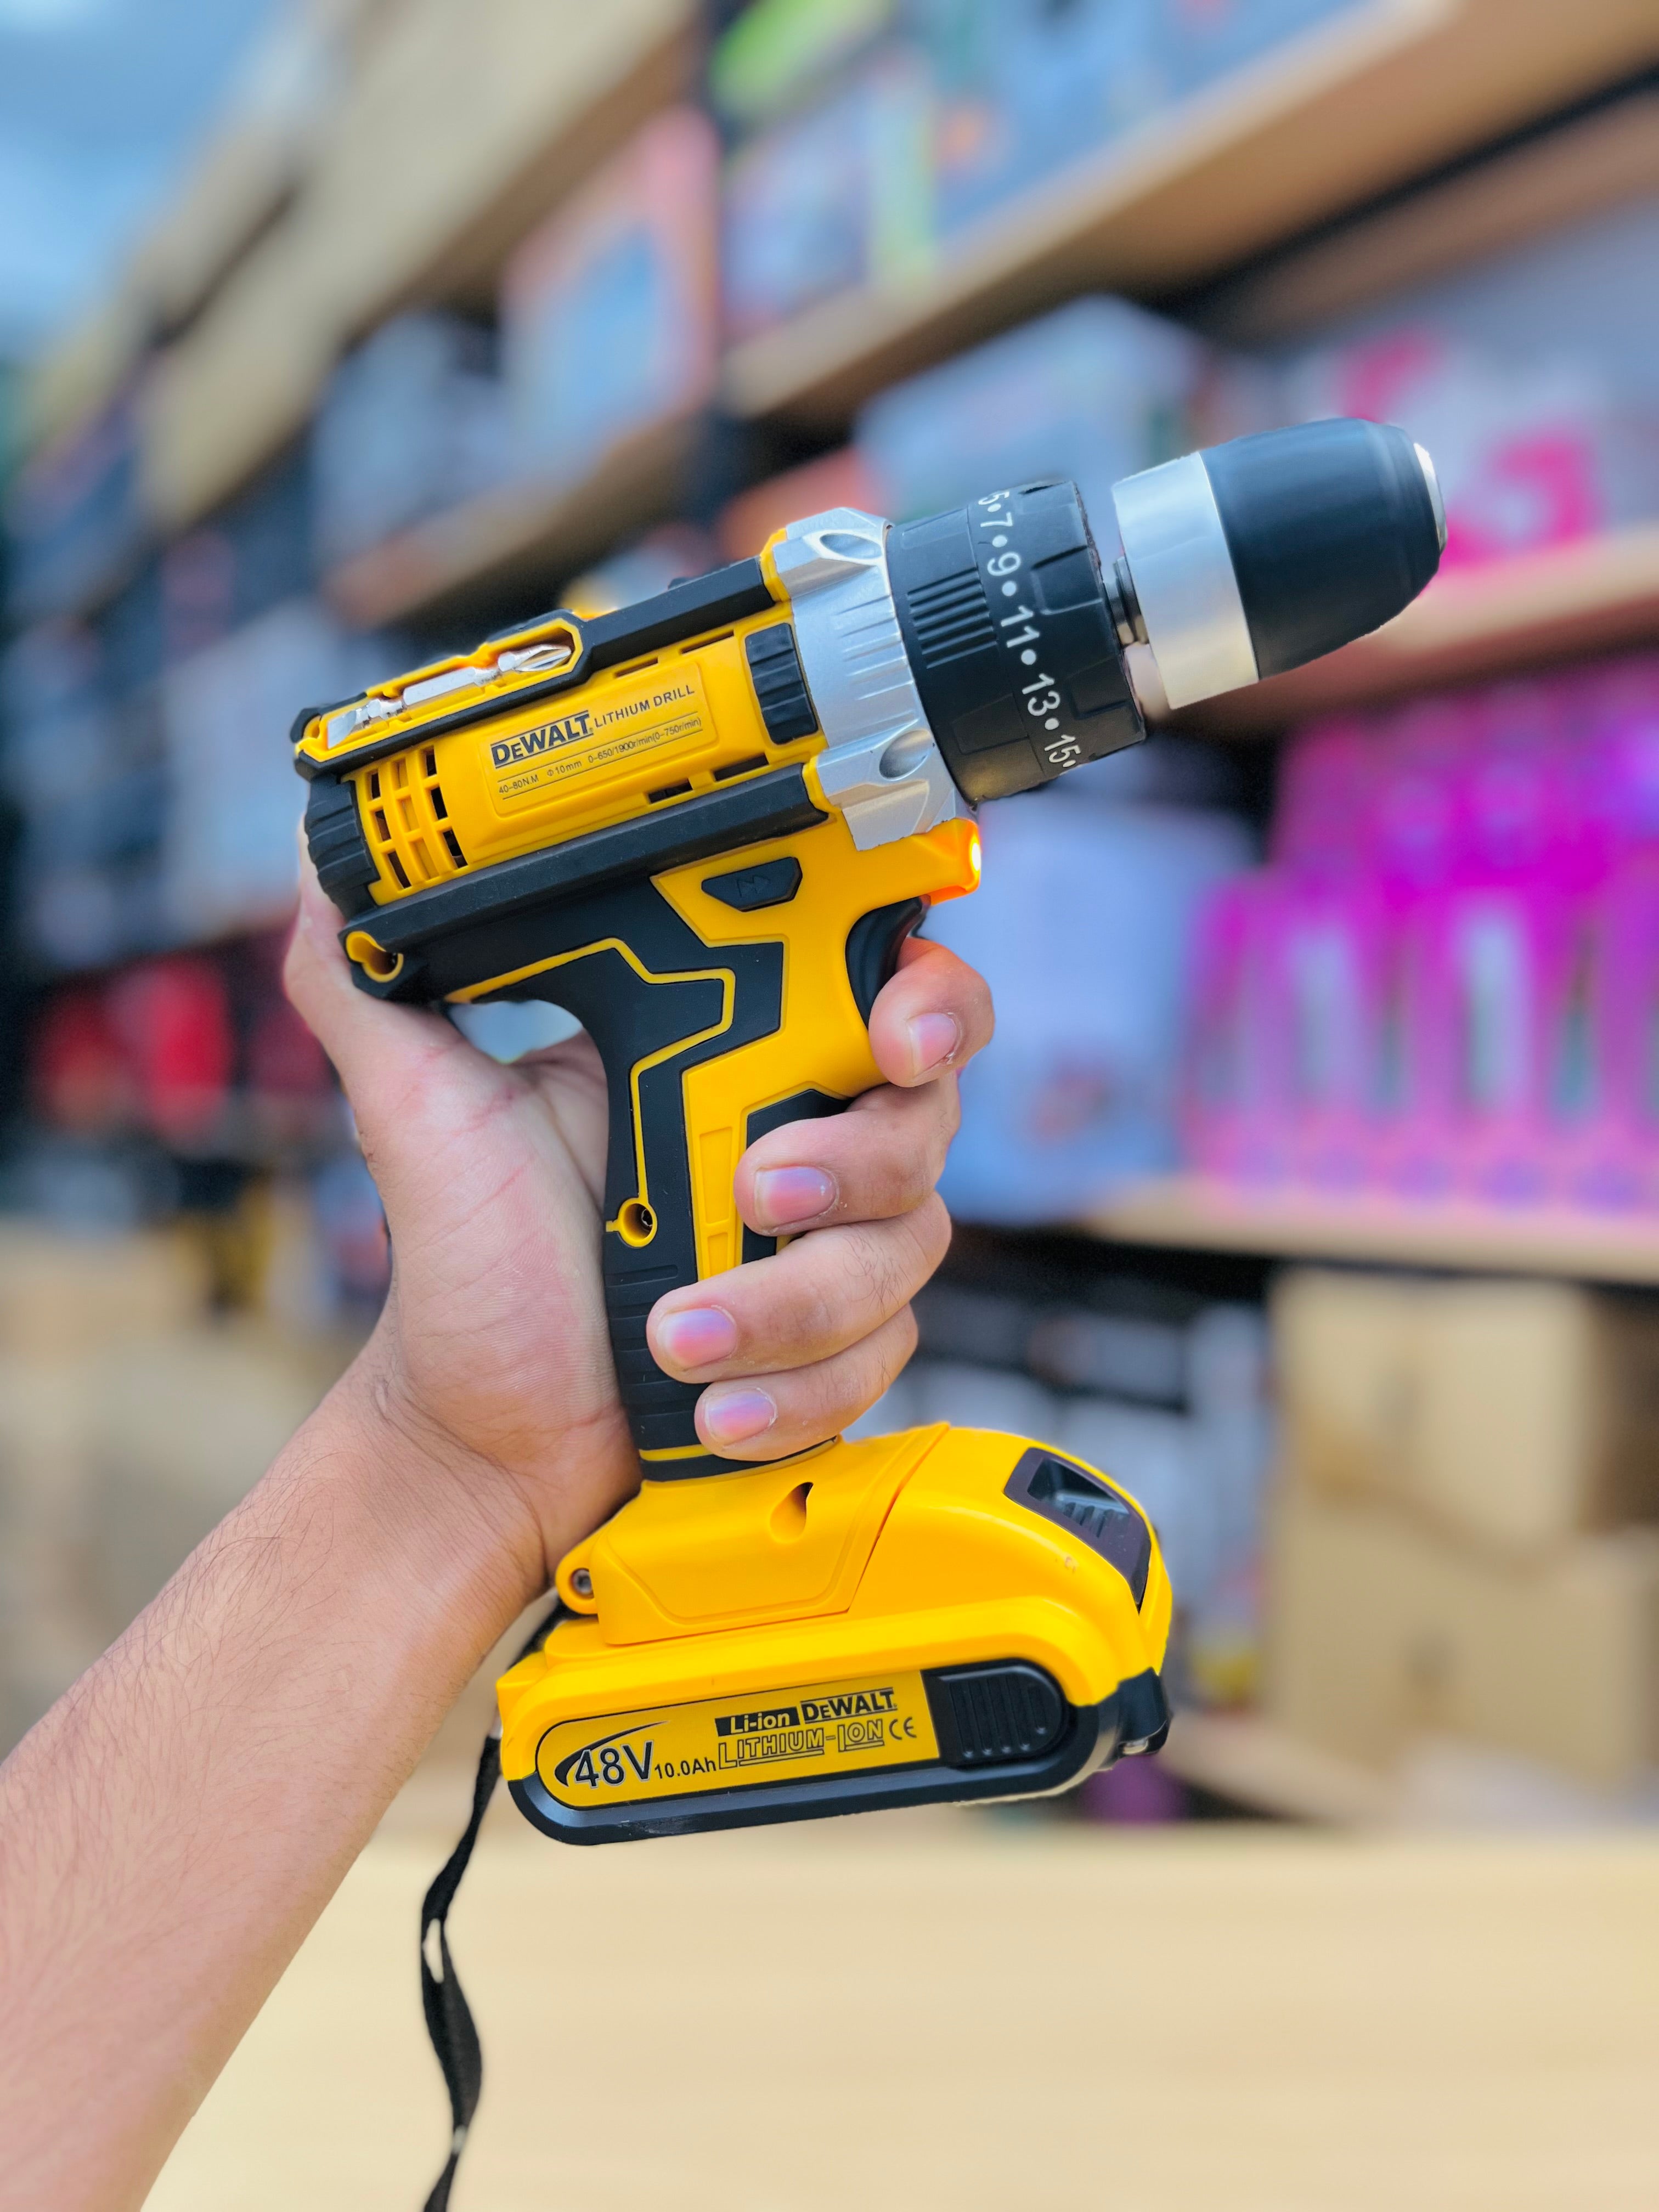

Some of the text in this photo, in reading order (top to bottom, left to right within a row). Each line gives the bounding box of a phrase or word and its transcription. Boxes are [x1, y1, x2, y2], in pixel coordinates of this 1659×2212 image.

[980, 512, 1013, 528] 7
[987, 552, 1022, 577] 9
[1000, 605, 1040, 648] 11
[594, 698, 651, 729] LITHIUM
[653, 684, 695, 707] DRILL
[1022, 673, 1061, 716] 13
[1044, 735, 1081, 763] 15
[718, 1718, 884, 1770] LITHIUM-ION
[730, 1711, 790, 1735] Li-ion
[574, 1739, 717, 1788] 48V 10.0Ah
